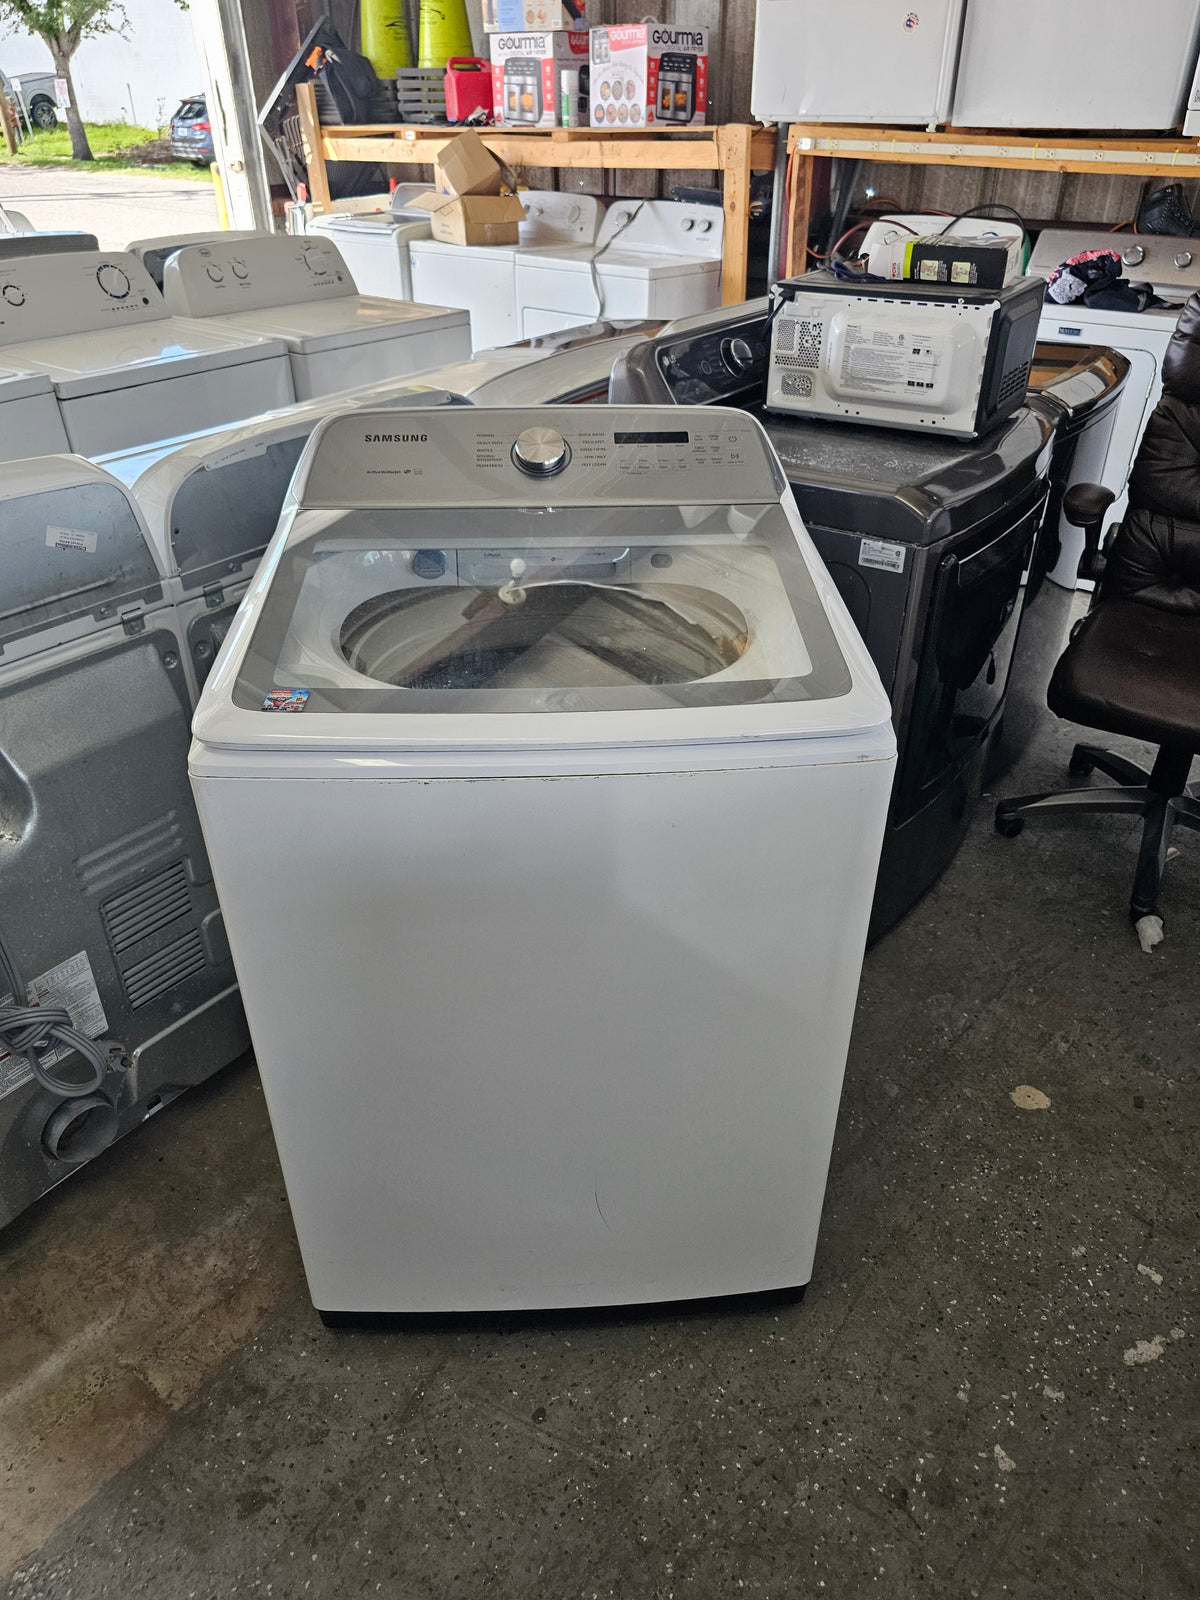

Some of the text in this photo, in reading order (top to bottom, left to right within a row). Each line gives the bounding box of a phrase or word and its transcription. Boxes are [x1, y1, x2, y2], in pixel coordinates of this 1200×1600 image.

[498, 36, 545, 50] Gourmia
[652, 28, 703, 46] Gourmia
[364, 434, 428, 443] SAMSUNG
